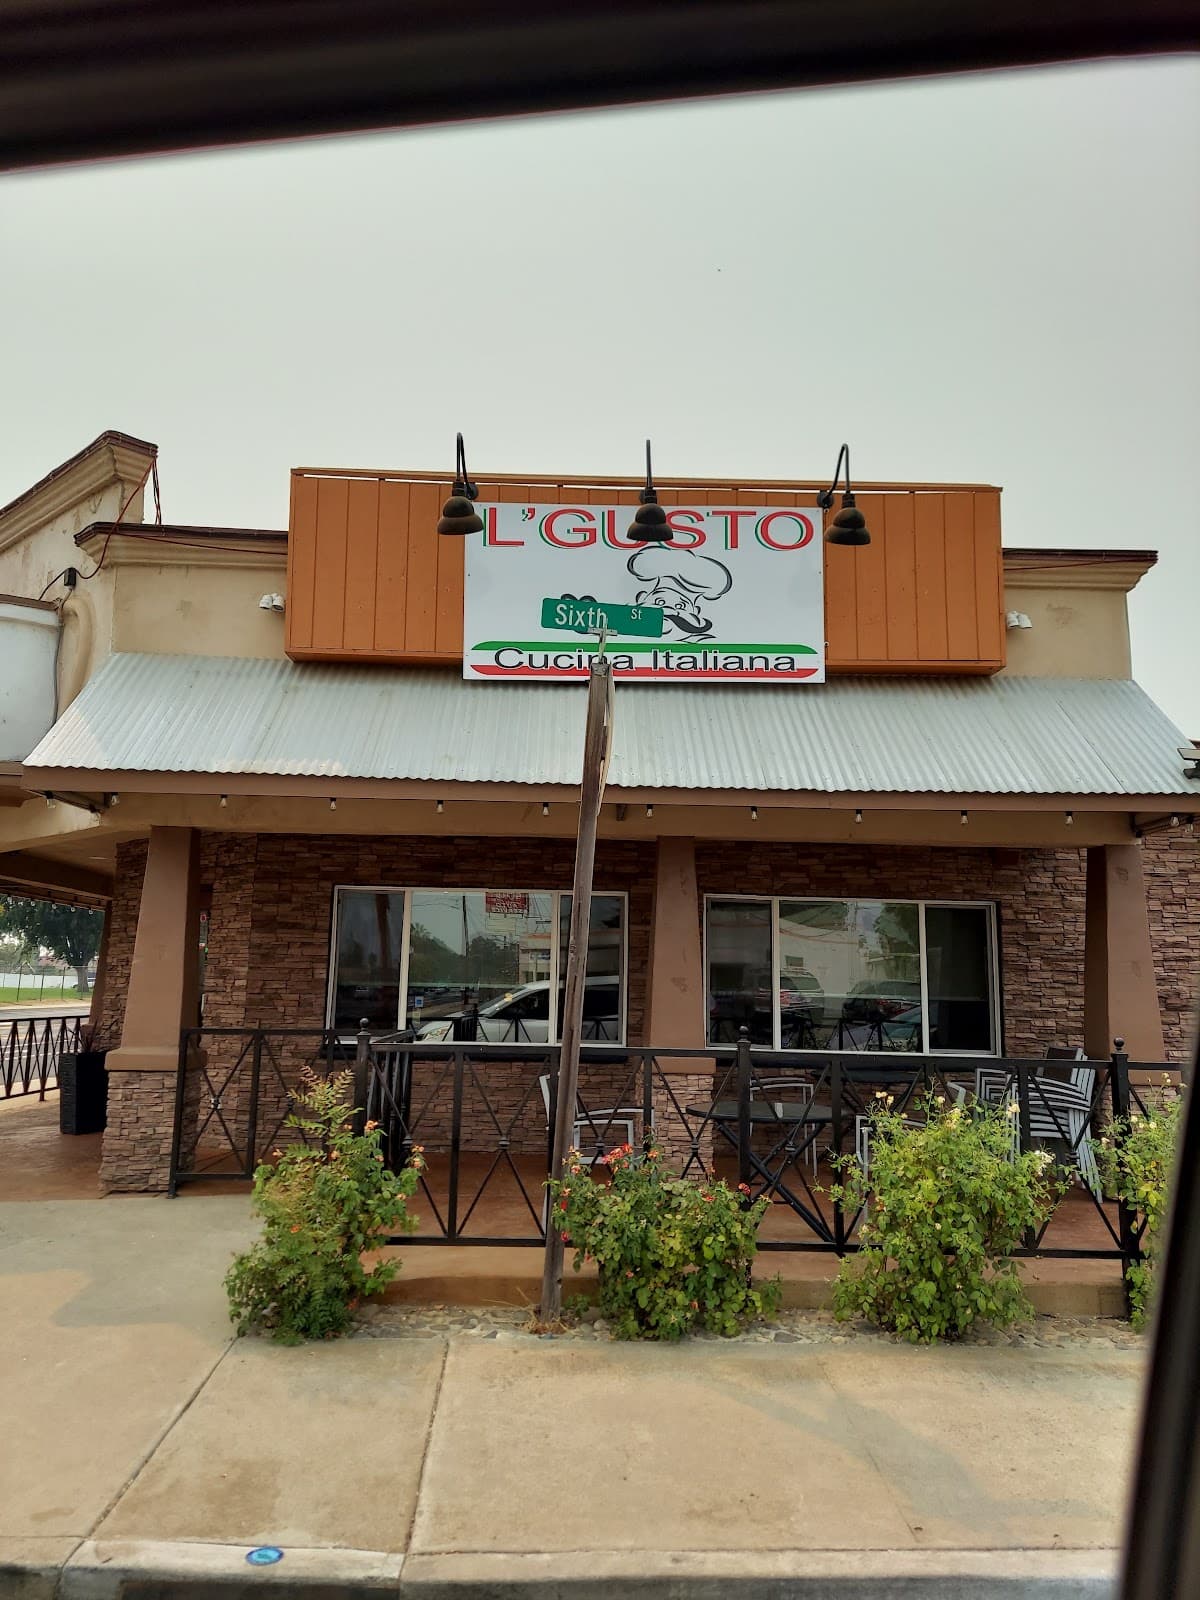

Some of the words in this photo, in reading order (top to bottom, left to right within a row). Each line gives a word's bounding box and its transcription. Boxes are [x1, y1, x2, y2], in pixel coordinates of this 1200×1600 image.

[482, 507, 815, 551] L'GUSTO
[554, 603, 608, 629] Sixth
[630, 608, 642, 620] St
[494, 648, 635, 671] Cucina
[651, 649, 797, 672] Italiana
